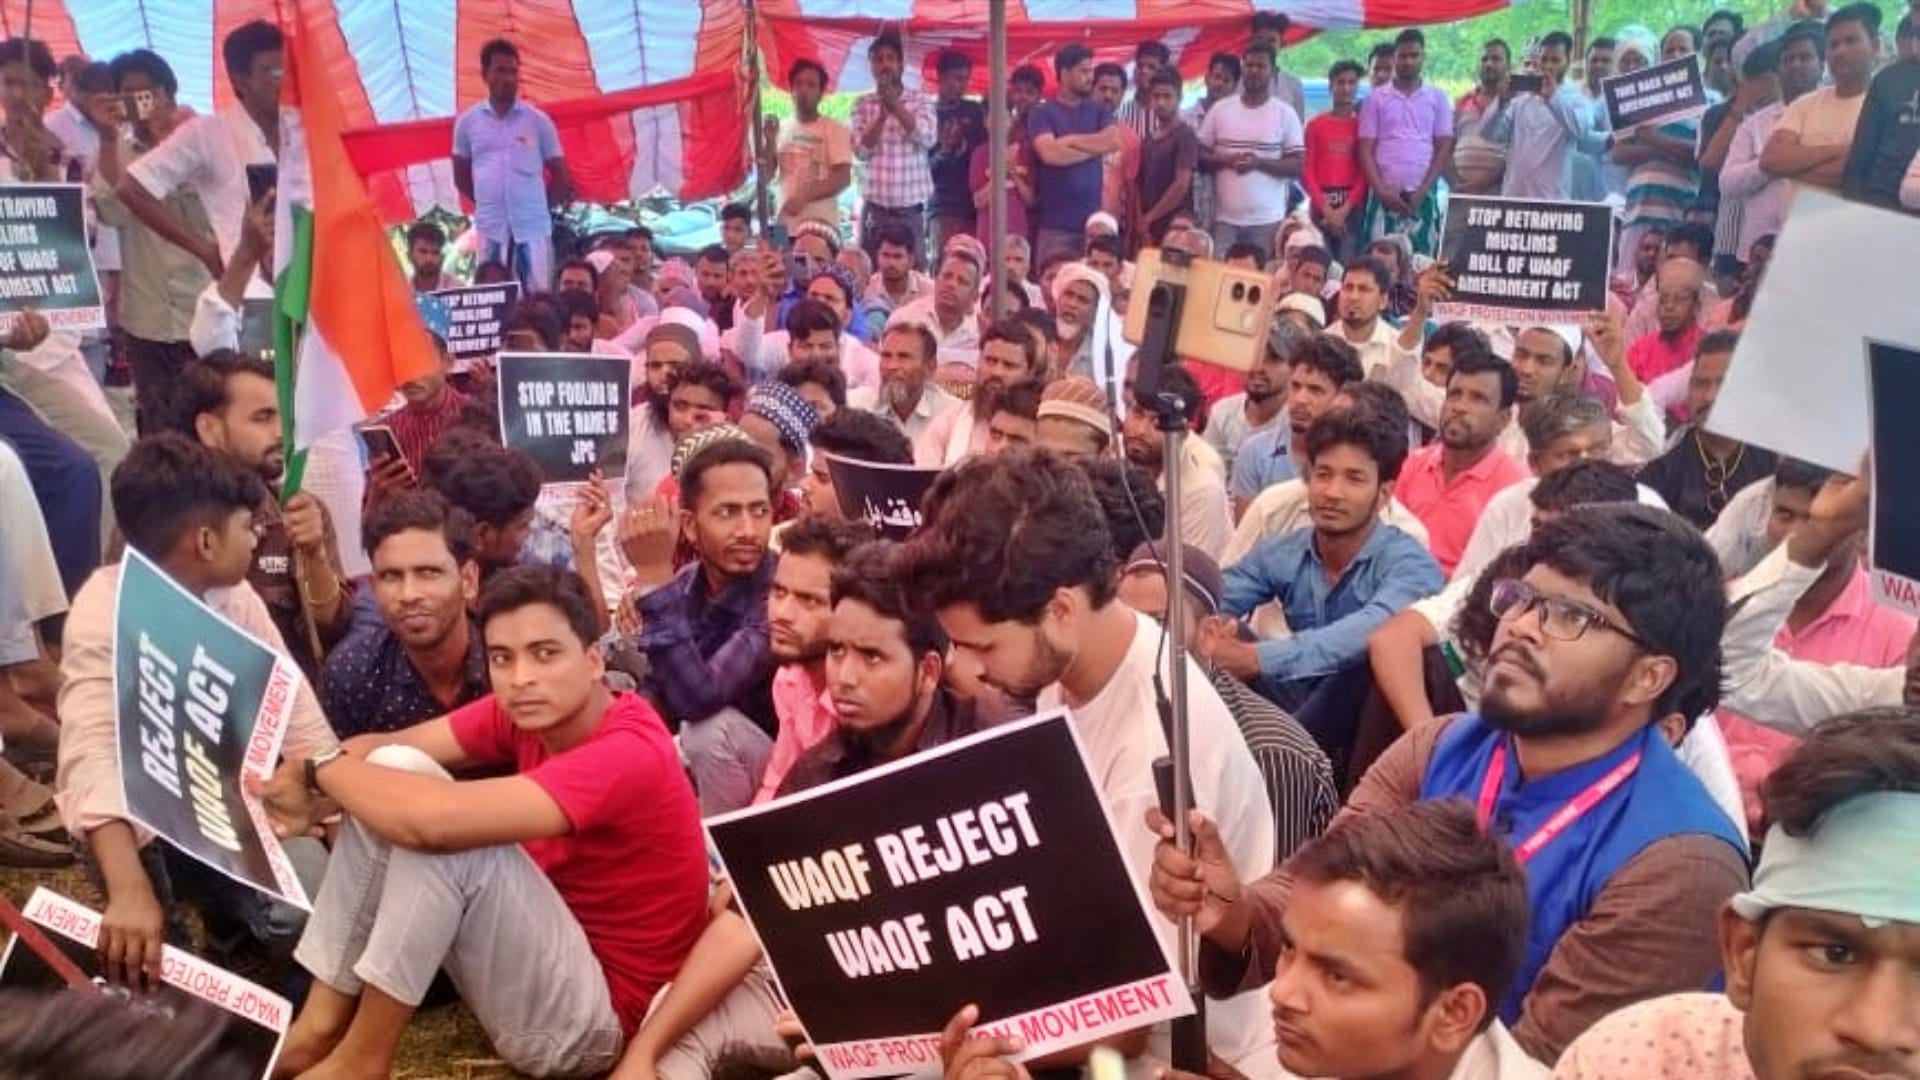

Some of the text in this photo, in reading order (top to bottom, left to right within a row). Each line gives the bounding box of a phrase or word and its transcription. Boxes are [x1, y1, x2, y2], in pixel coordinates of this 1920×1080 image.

[1468, 208, 1585, 232] STOP BETRAYING
[1485, 232, 1557, 253] MUSLIMS
[1468, 254, 1572, 277] ROLL OF WAQF
[1457, 275, 1582, 299] AMENDMENT ACT
[517, 381, 554, 407] STOP
[525, 411, 543, 437] IN
[545, 411, 572, 435] THE
[573, 411, 606, 435] NAME
[571, 439, 596, 465] JPC
[1882, 573, 1920, 610] WA
[139, 632, 182, 799] REJECT
[247, 667, 294, 763] MOVEMENT
[183, 643, 242, 851] WAQF ACT
[768, 792, 1042, 911] WAQF REJECT
[31, 900, 99, 944] VEMENT
[825, 885, 1038, 979] WAQF ACT
[160, 957, 229, 1007] PROTEC
[231, 990, 281, 1027] WAQF
[826, 1044, 877, 1072] WAQF
[1021, 977, 1174, 1045] MOVEMENT
